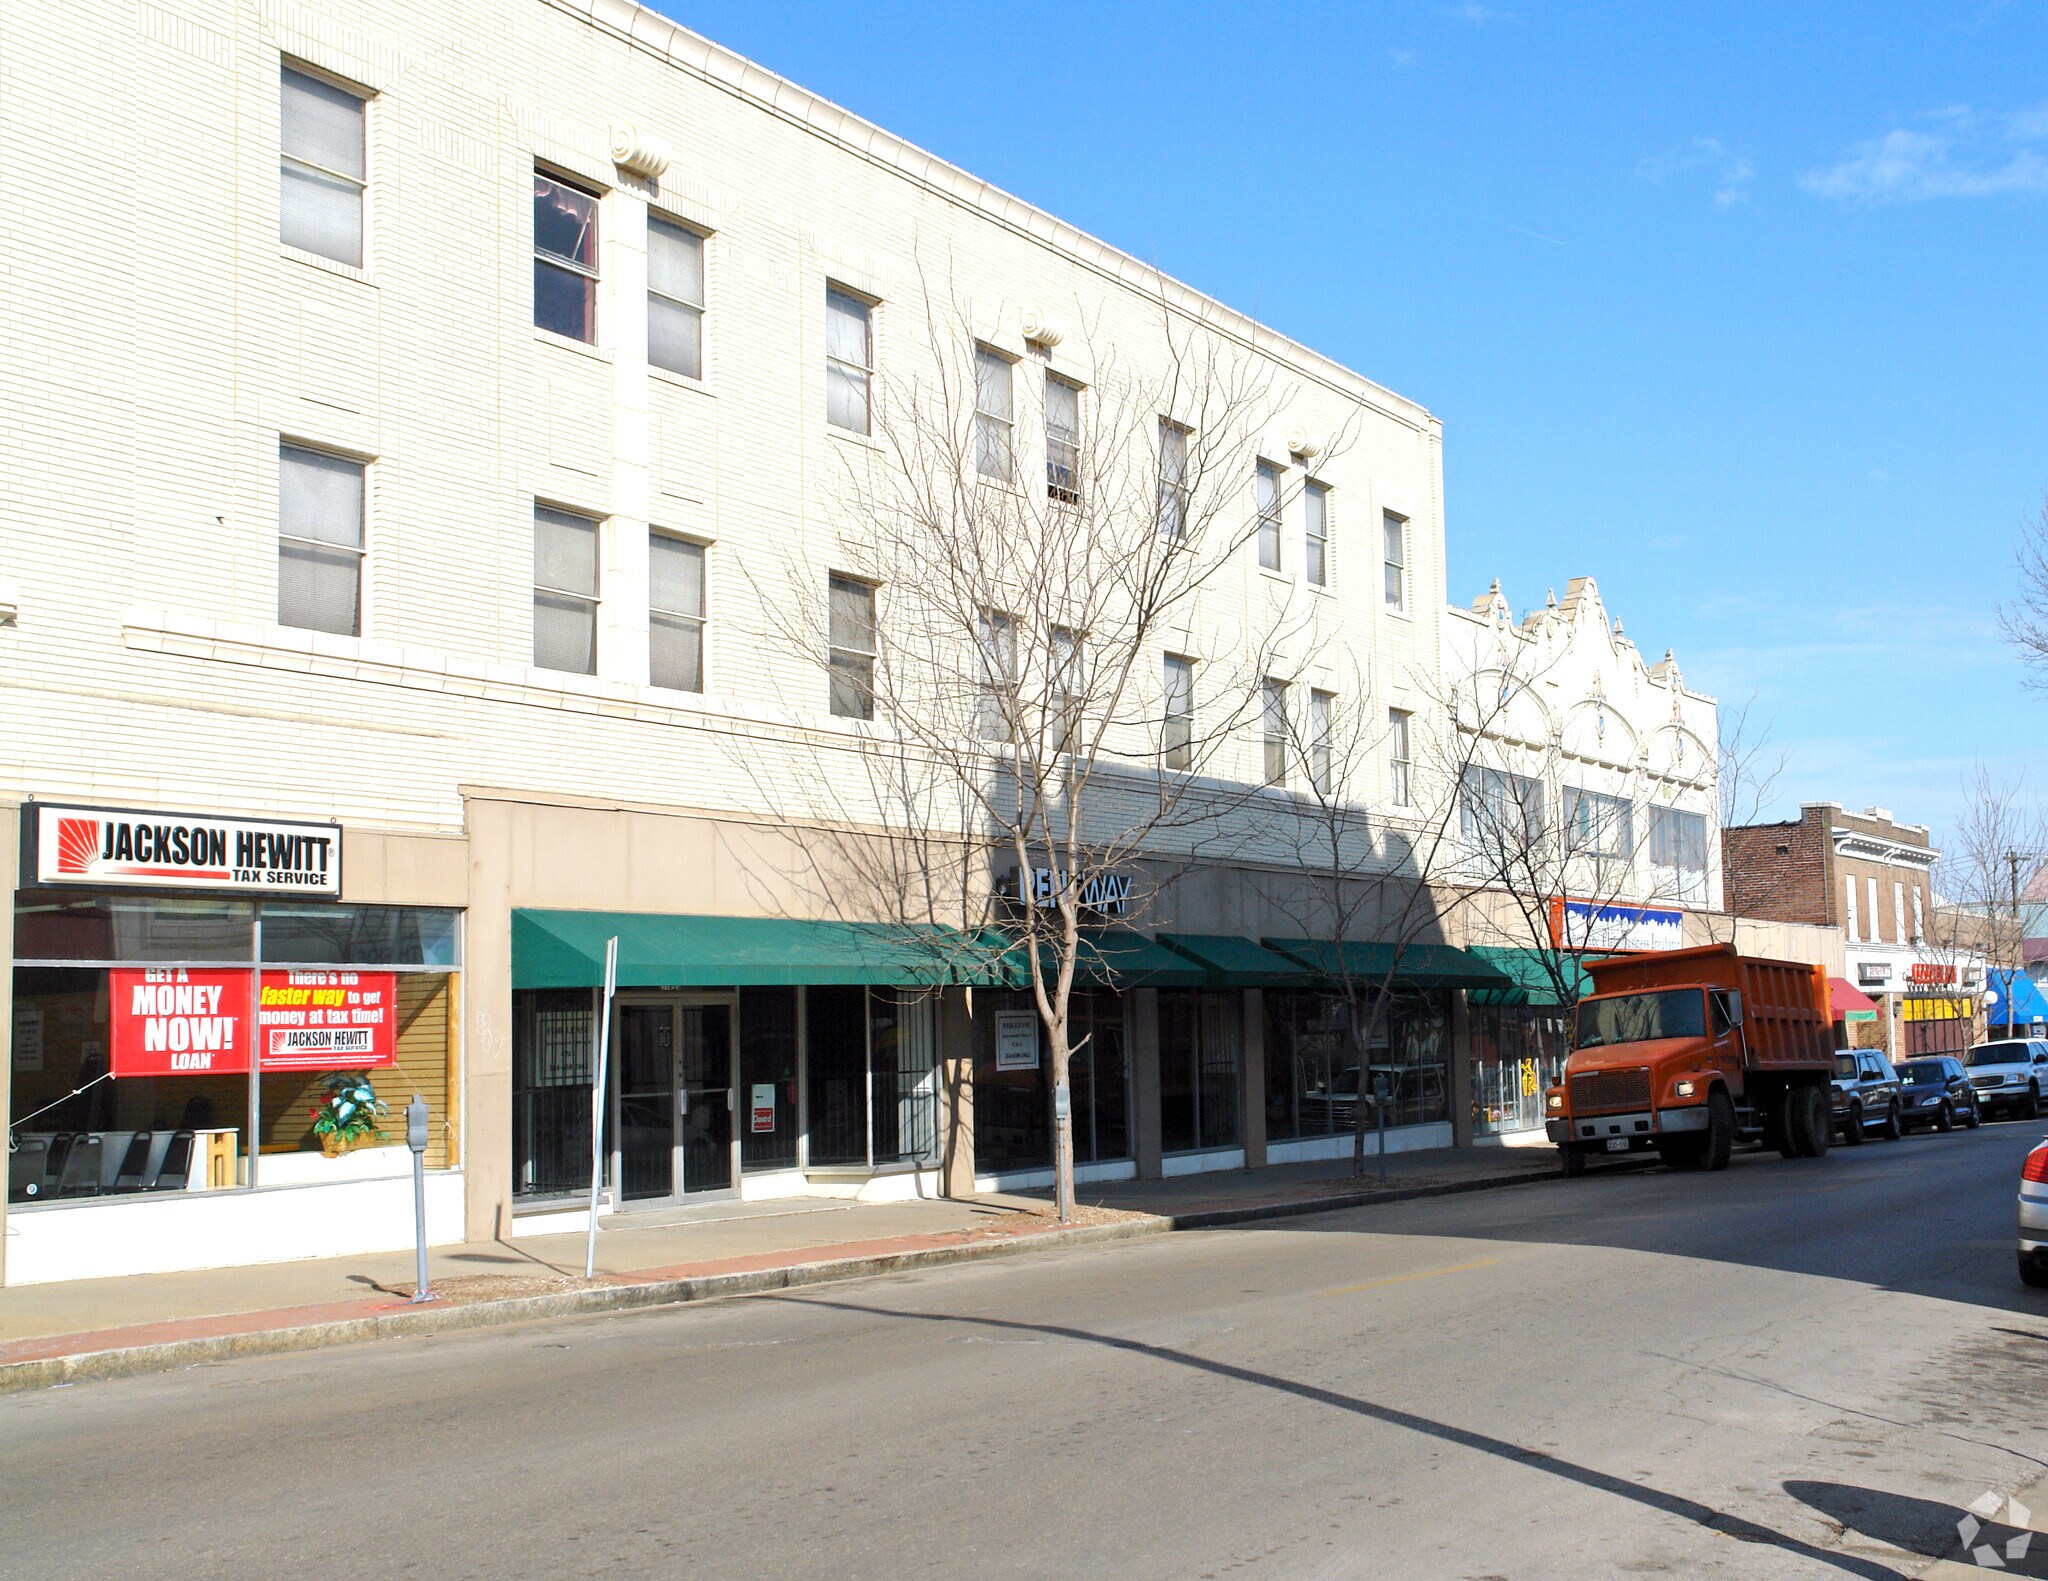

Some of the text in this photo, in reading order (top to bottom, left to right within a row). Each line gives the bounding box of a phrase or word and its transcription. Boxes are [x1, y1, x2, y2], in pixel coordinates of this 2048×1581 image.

[102, 821, 331, 872] JACKSON HEWITT
[232, 869, 328, 885] TAX SERVICE
[145, 967, 189, 983] GET A
[288, 969, 359, 986] There's no
[131, 985, 223, 1016] MONEY
[260, 986, 381, 1007] faster way to get
[259, 1007, 384, 1026] money at tax time!
[145, 1016, 234, 1052] NOW!
[287, 1030, 369, 1047] JACKSON HEWITT
